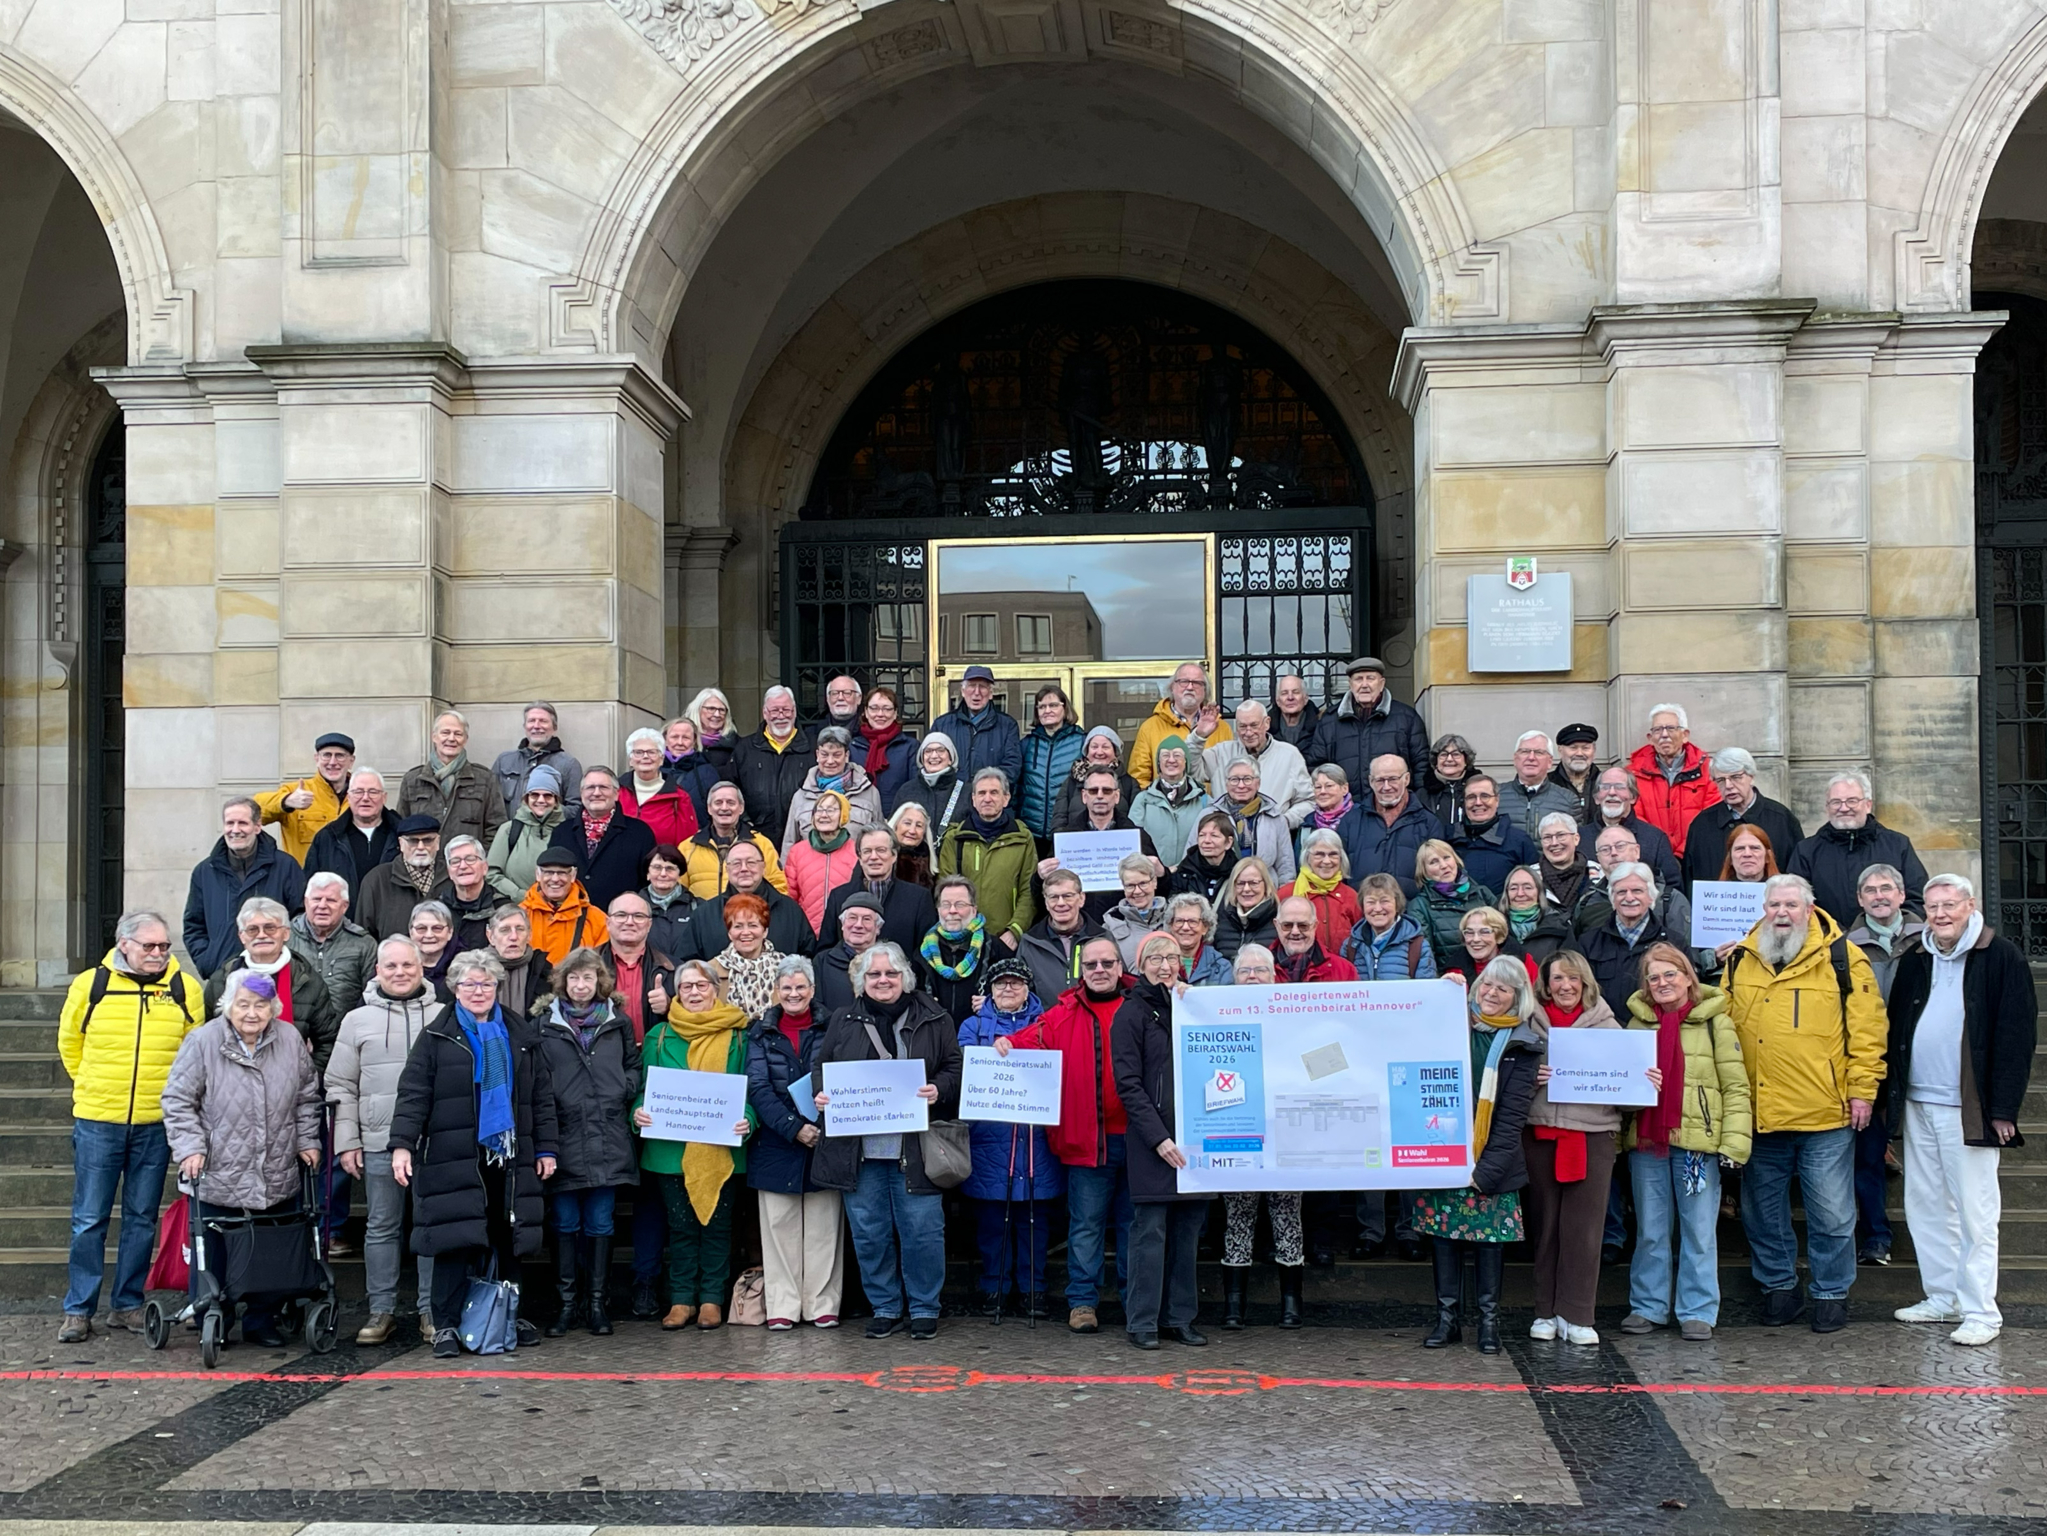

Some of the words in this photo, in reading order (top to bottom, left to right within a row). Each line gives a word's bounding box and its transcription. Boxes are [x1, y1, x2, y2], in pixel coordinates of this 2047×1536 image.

[1499, 598, 1544, 607] RATHAUS
[1704, 891, 1718, 899] Wir
[1740, 892, 1756, 900] hier
[1703, 904, 1718, 912] Wir
[1218, 1007, 1242, 1016] zum
[1247, 1006, 1264, 1015] 13.
[1268, 1003, 1356, 1014] Seniorenbeirat
[1188, 1031, 1256, 1042] SENIOREN-
[1188, 1044, 1256, 1053] BEIRATSWAHL
[970, 1057, 1052, 1069] Seniorenbeiratswahl
[1209, 1055, 1236, 1064] 2026
[993, 1072, 1014, 1081] 2026
[1420, 1068, 1458, 1080] MEINE
[1556, 1068, 1607, 1078] Gemeinsam
[1610, 1070, 1629, 1078] sind
[968, 1084, 986, 1093] Über
[1001, 1088, 1027, 1097] Jahre?
[1421, 1084, 1458, 1093] STIMME
[652, 1092, 711, 1104] Seniorenbeirat
[1207, 1097, 1244, 1108] BRIEFWAHL
[1422, 1095, 1459, 1108] ZÄHLT!
[832, 1101, 860, 1109] nutzen
[863, 1099, 885, 1107] heißt
[966, 1100, 989, 1108] Nutze
[992, 1101, 1015, 1110] deine
[1018, 1103, 1050, 1112] Stimme
[650, 1106, 723, 1119] Landeshauptstadt
[832, 1114, 881, 1124] Demokratie
[666, 1121, 706, 1131] Hannover
[1212, 1158, 1234, 1167] MIT
